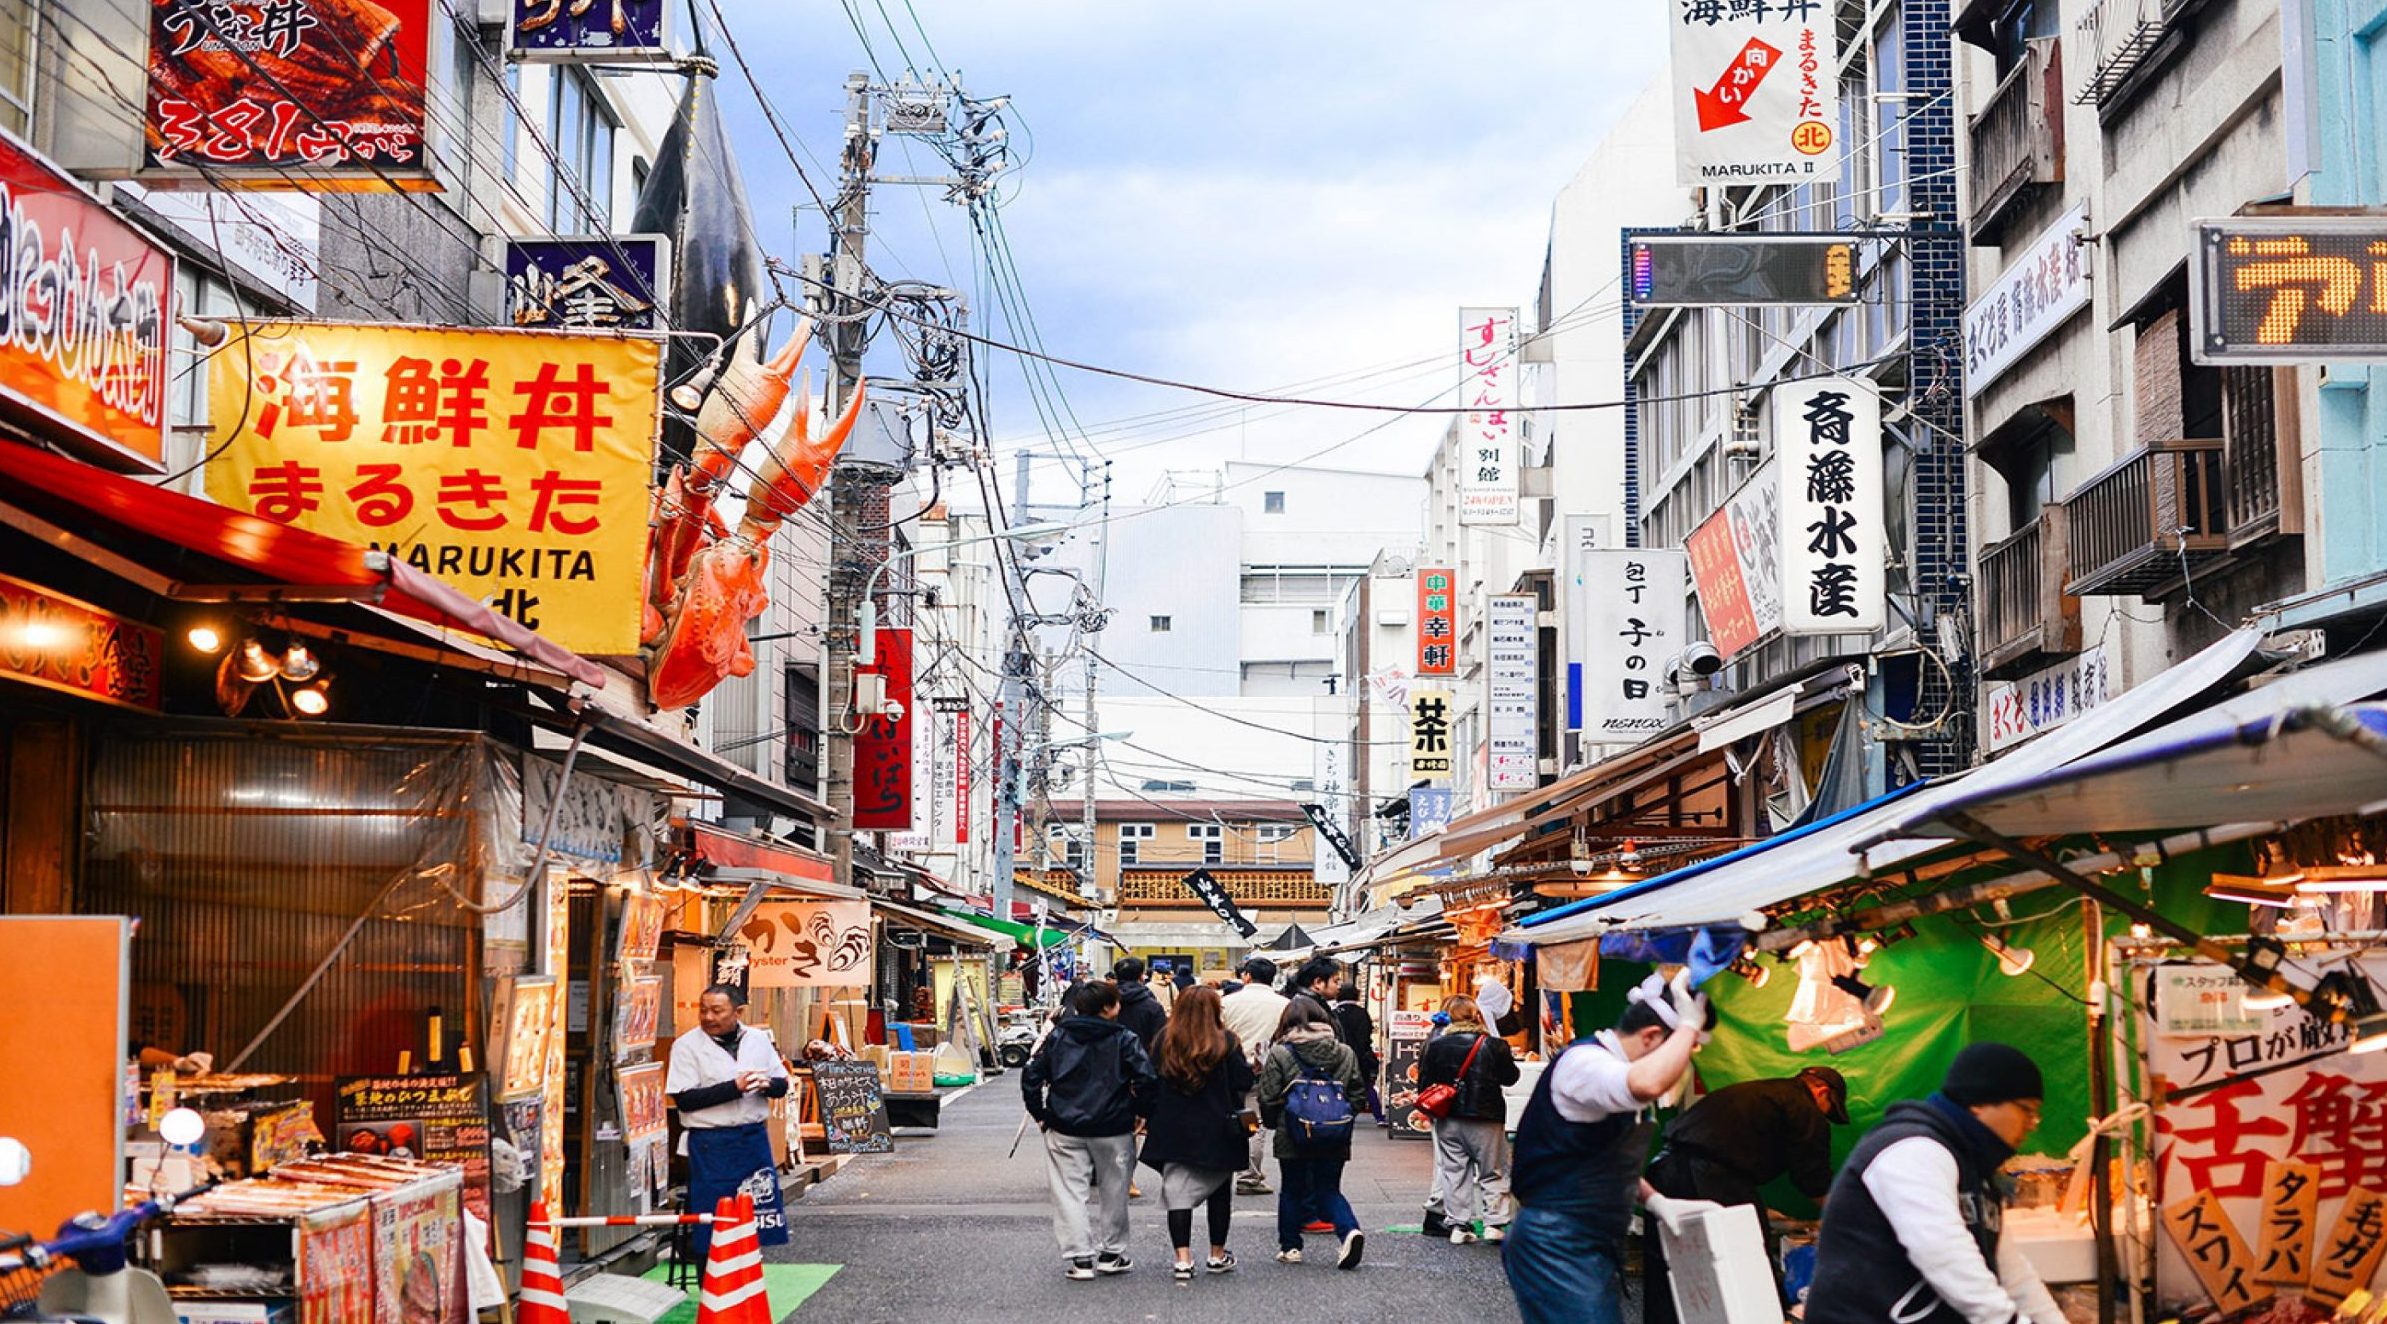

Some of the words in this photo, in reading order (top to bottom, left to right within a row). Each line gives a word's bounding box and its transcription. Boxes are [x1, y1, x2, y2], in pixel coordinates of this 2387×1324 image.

[1719, 48, 1768, 104] 向かい
[1798, 28, 1823, 118] まるきた
[1702, 162, 1797, 178] MARUKITA
[254, 352, 613, 452] 海鮮丼
[1466, 316, 1509, 441] すしざんまい
[248, 460, 603, 535] まるきた
[1478, 448, 1500, 482] 別館
[1413, 698, 1448, 752] 茶
[2259, 1170, 2309, 1274] タラバ
[2312, 1198, 2384, 1301] 毛ガニ
